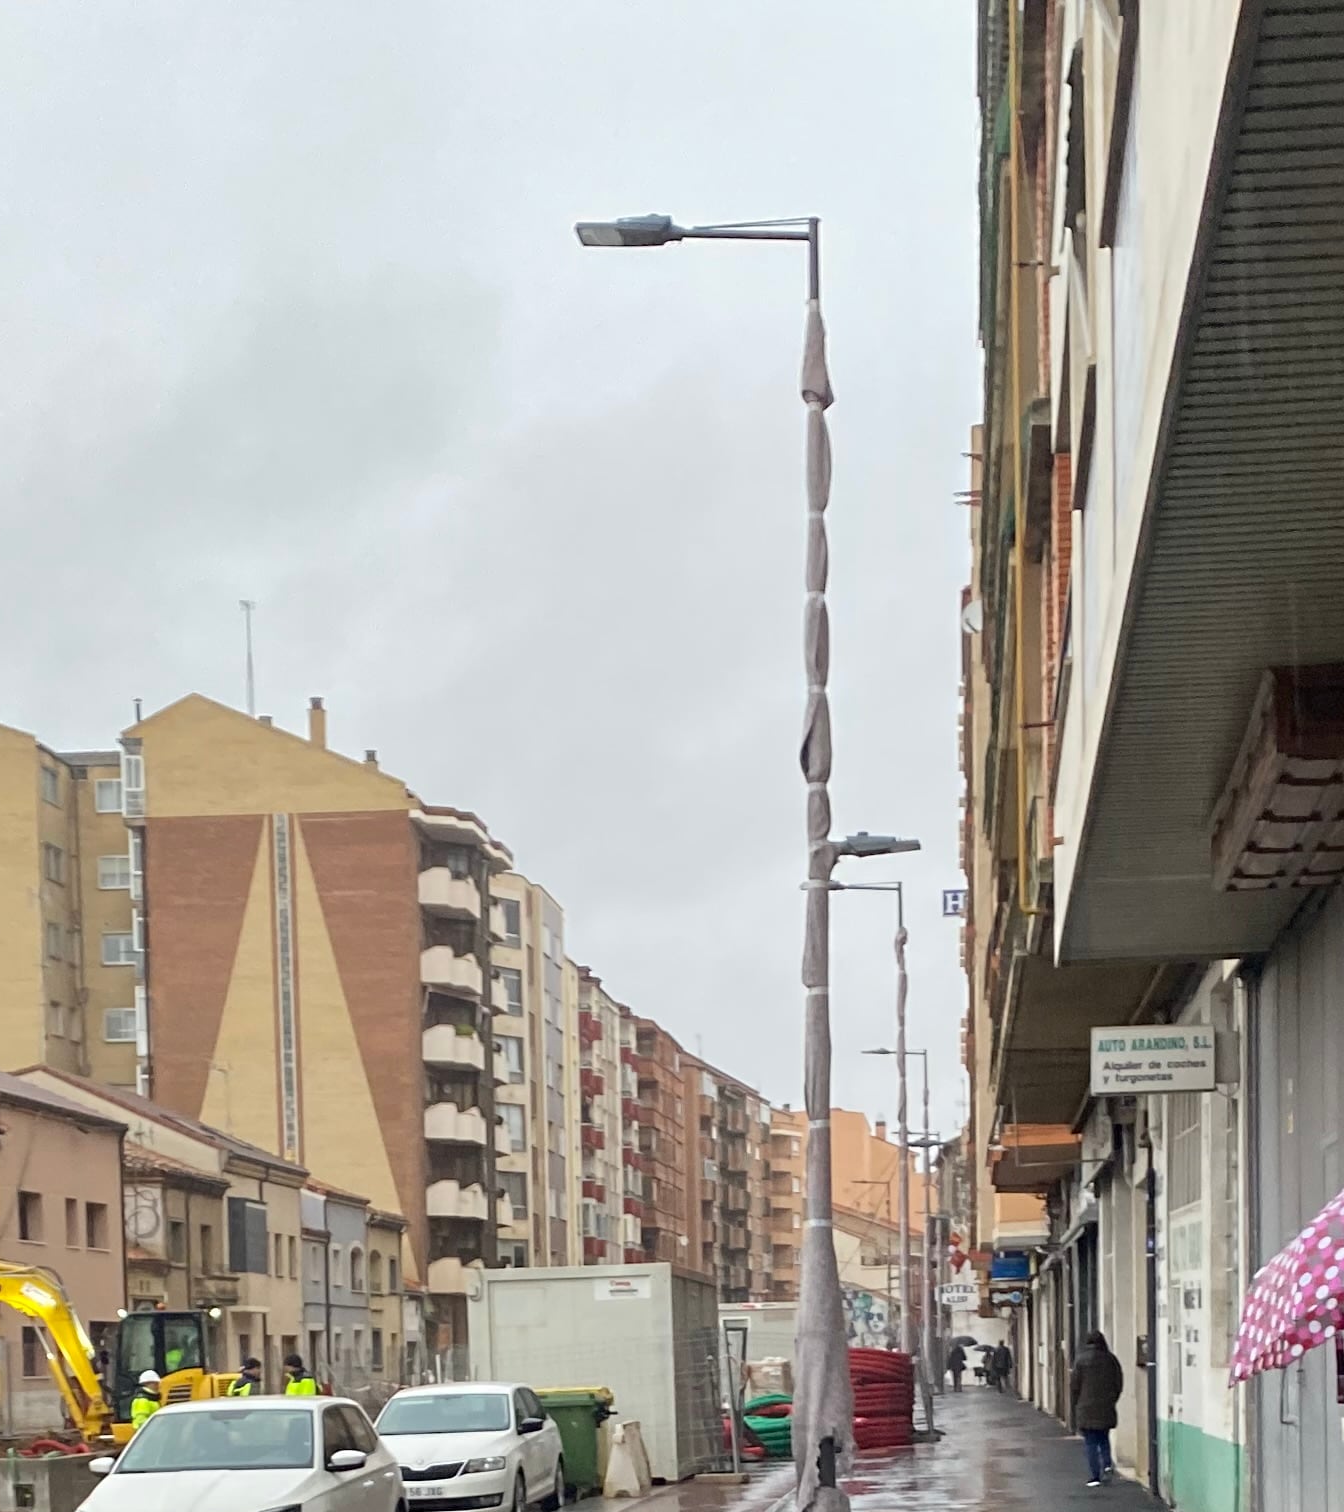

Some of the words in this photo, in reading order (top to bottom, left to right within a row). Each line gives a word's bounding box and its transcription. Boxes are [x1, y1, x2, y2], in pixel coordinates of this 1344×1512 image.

[1098, 1039, 1126, 1052] AUTO
[1102, 1060, 1143, 1072] Alquiler
[1148, 1060, 1162, 1070] de
[1167, 1059, 1207, 1069] coches
